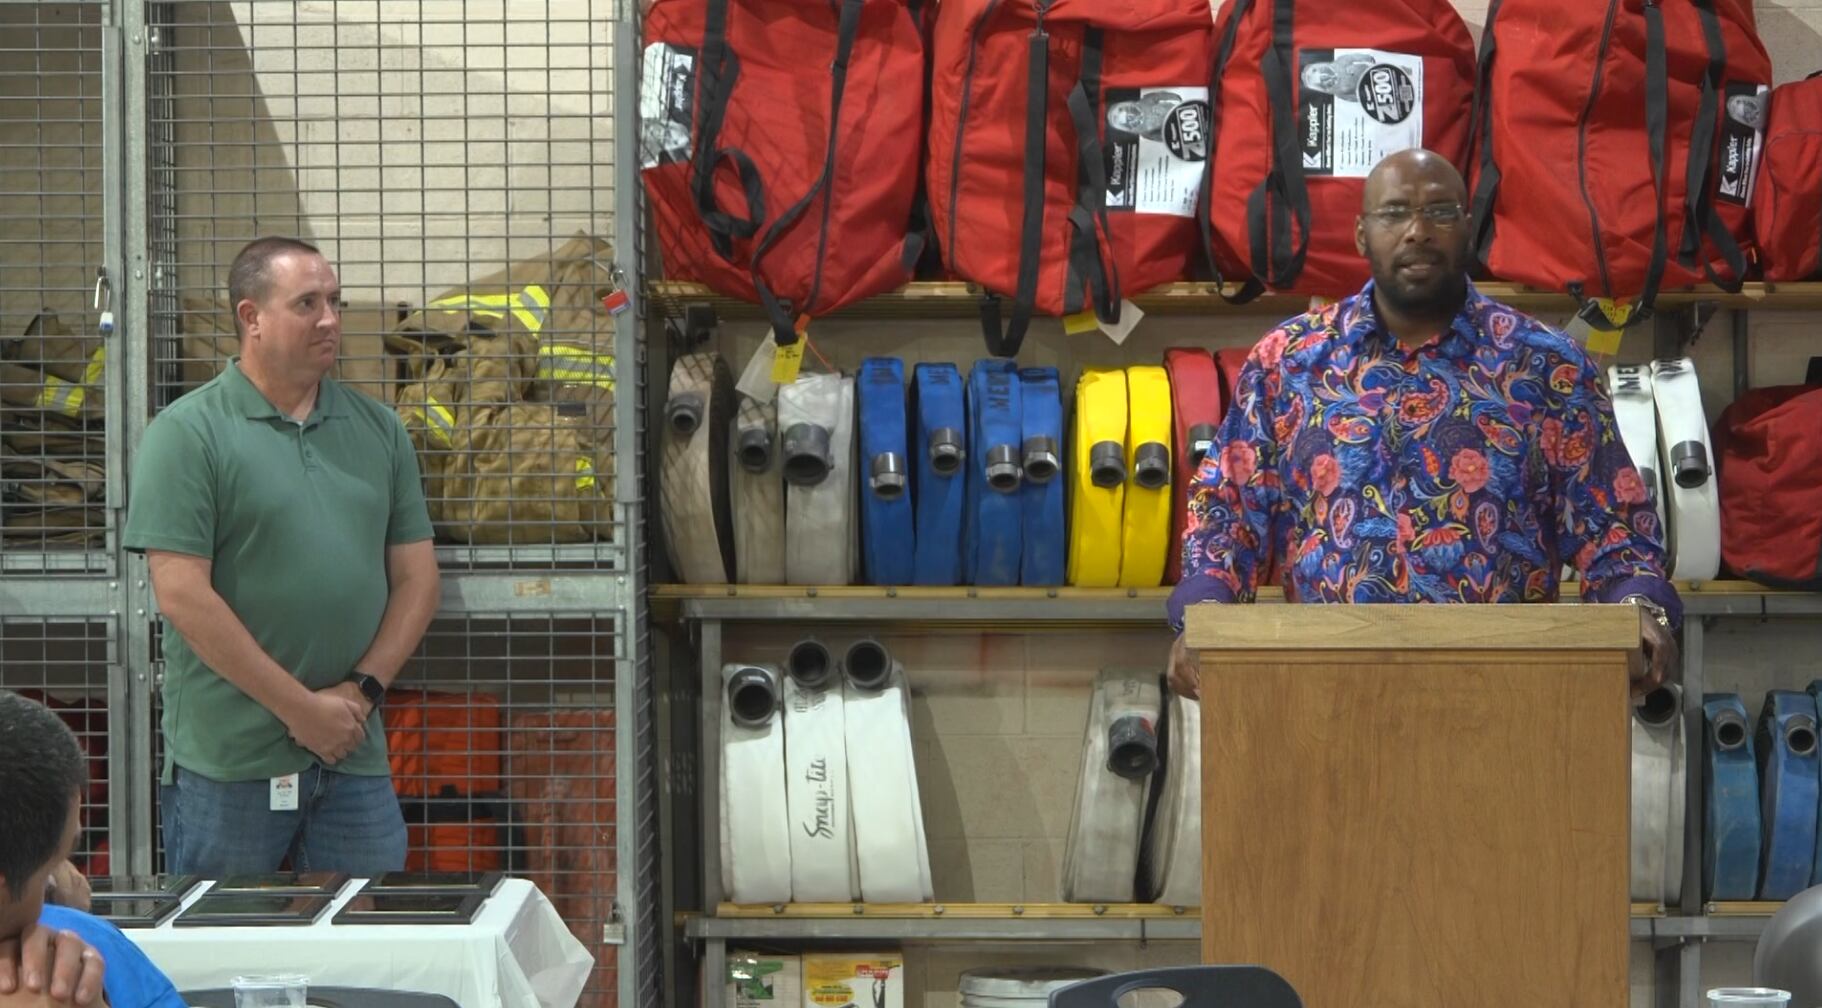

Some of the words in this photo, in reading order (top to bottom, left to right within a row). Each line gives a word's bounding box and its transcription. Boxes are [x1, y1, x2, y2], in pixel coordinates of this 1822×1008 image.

[1306, 103, 1320, 148] Kappler
[1110, 142, 1124, 186] Kappler
[1726, 133, 1739, 173] Kappler
